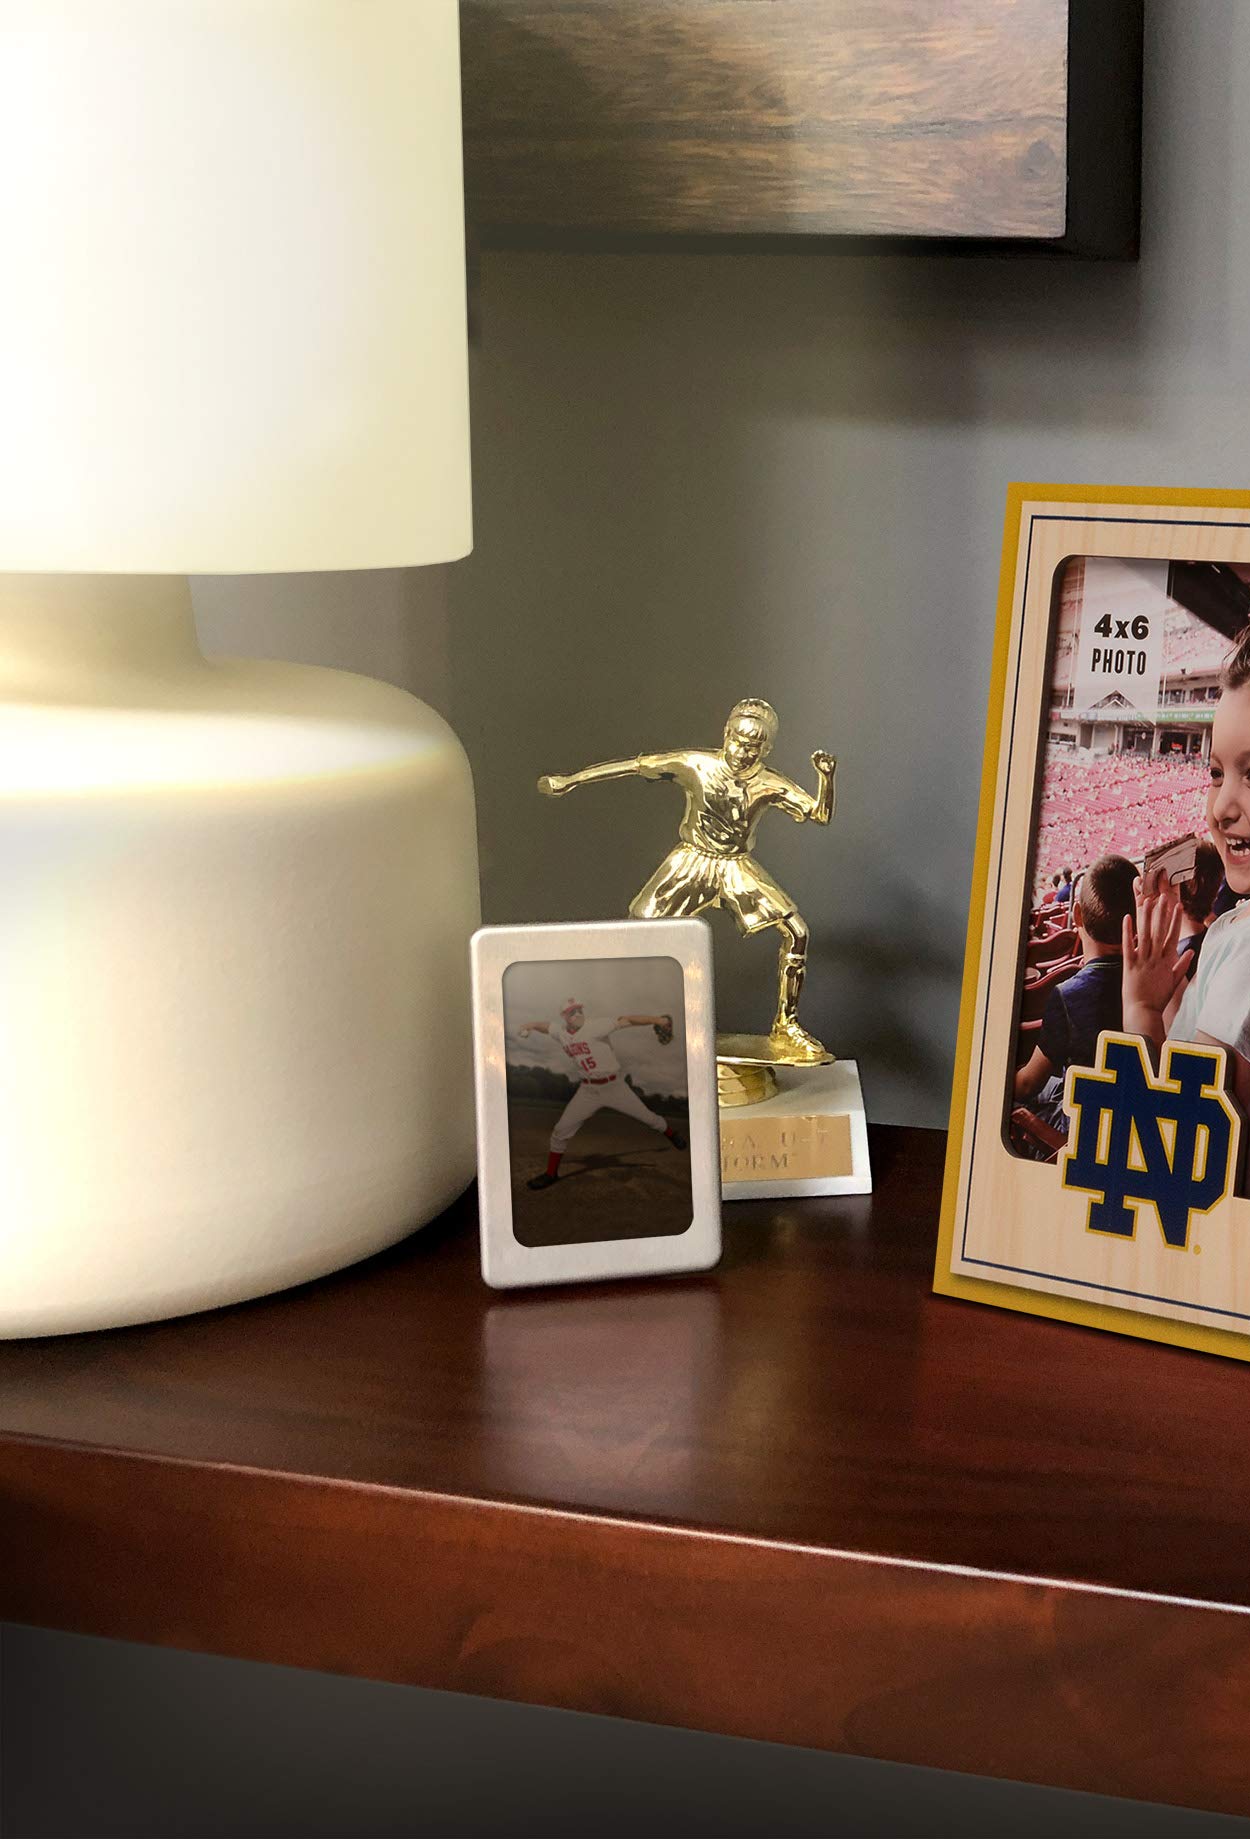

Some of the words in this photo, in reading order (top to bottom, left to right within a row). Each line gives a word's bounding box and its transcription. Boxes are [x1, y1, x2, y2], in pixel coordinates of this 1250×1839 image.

[1094, 613, 1150, 641] 4x6
[1091, 647, 1147, 676] PHOTO
[580, 1055, 597, 1073] 15
